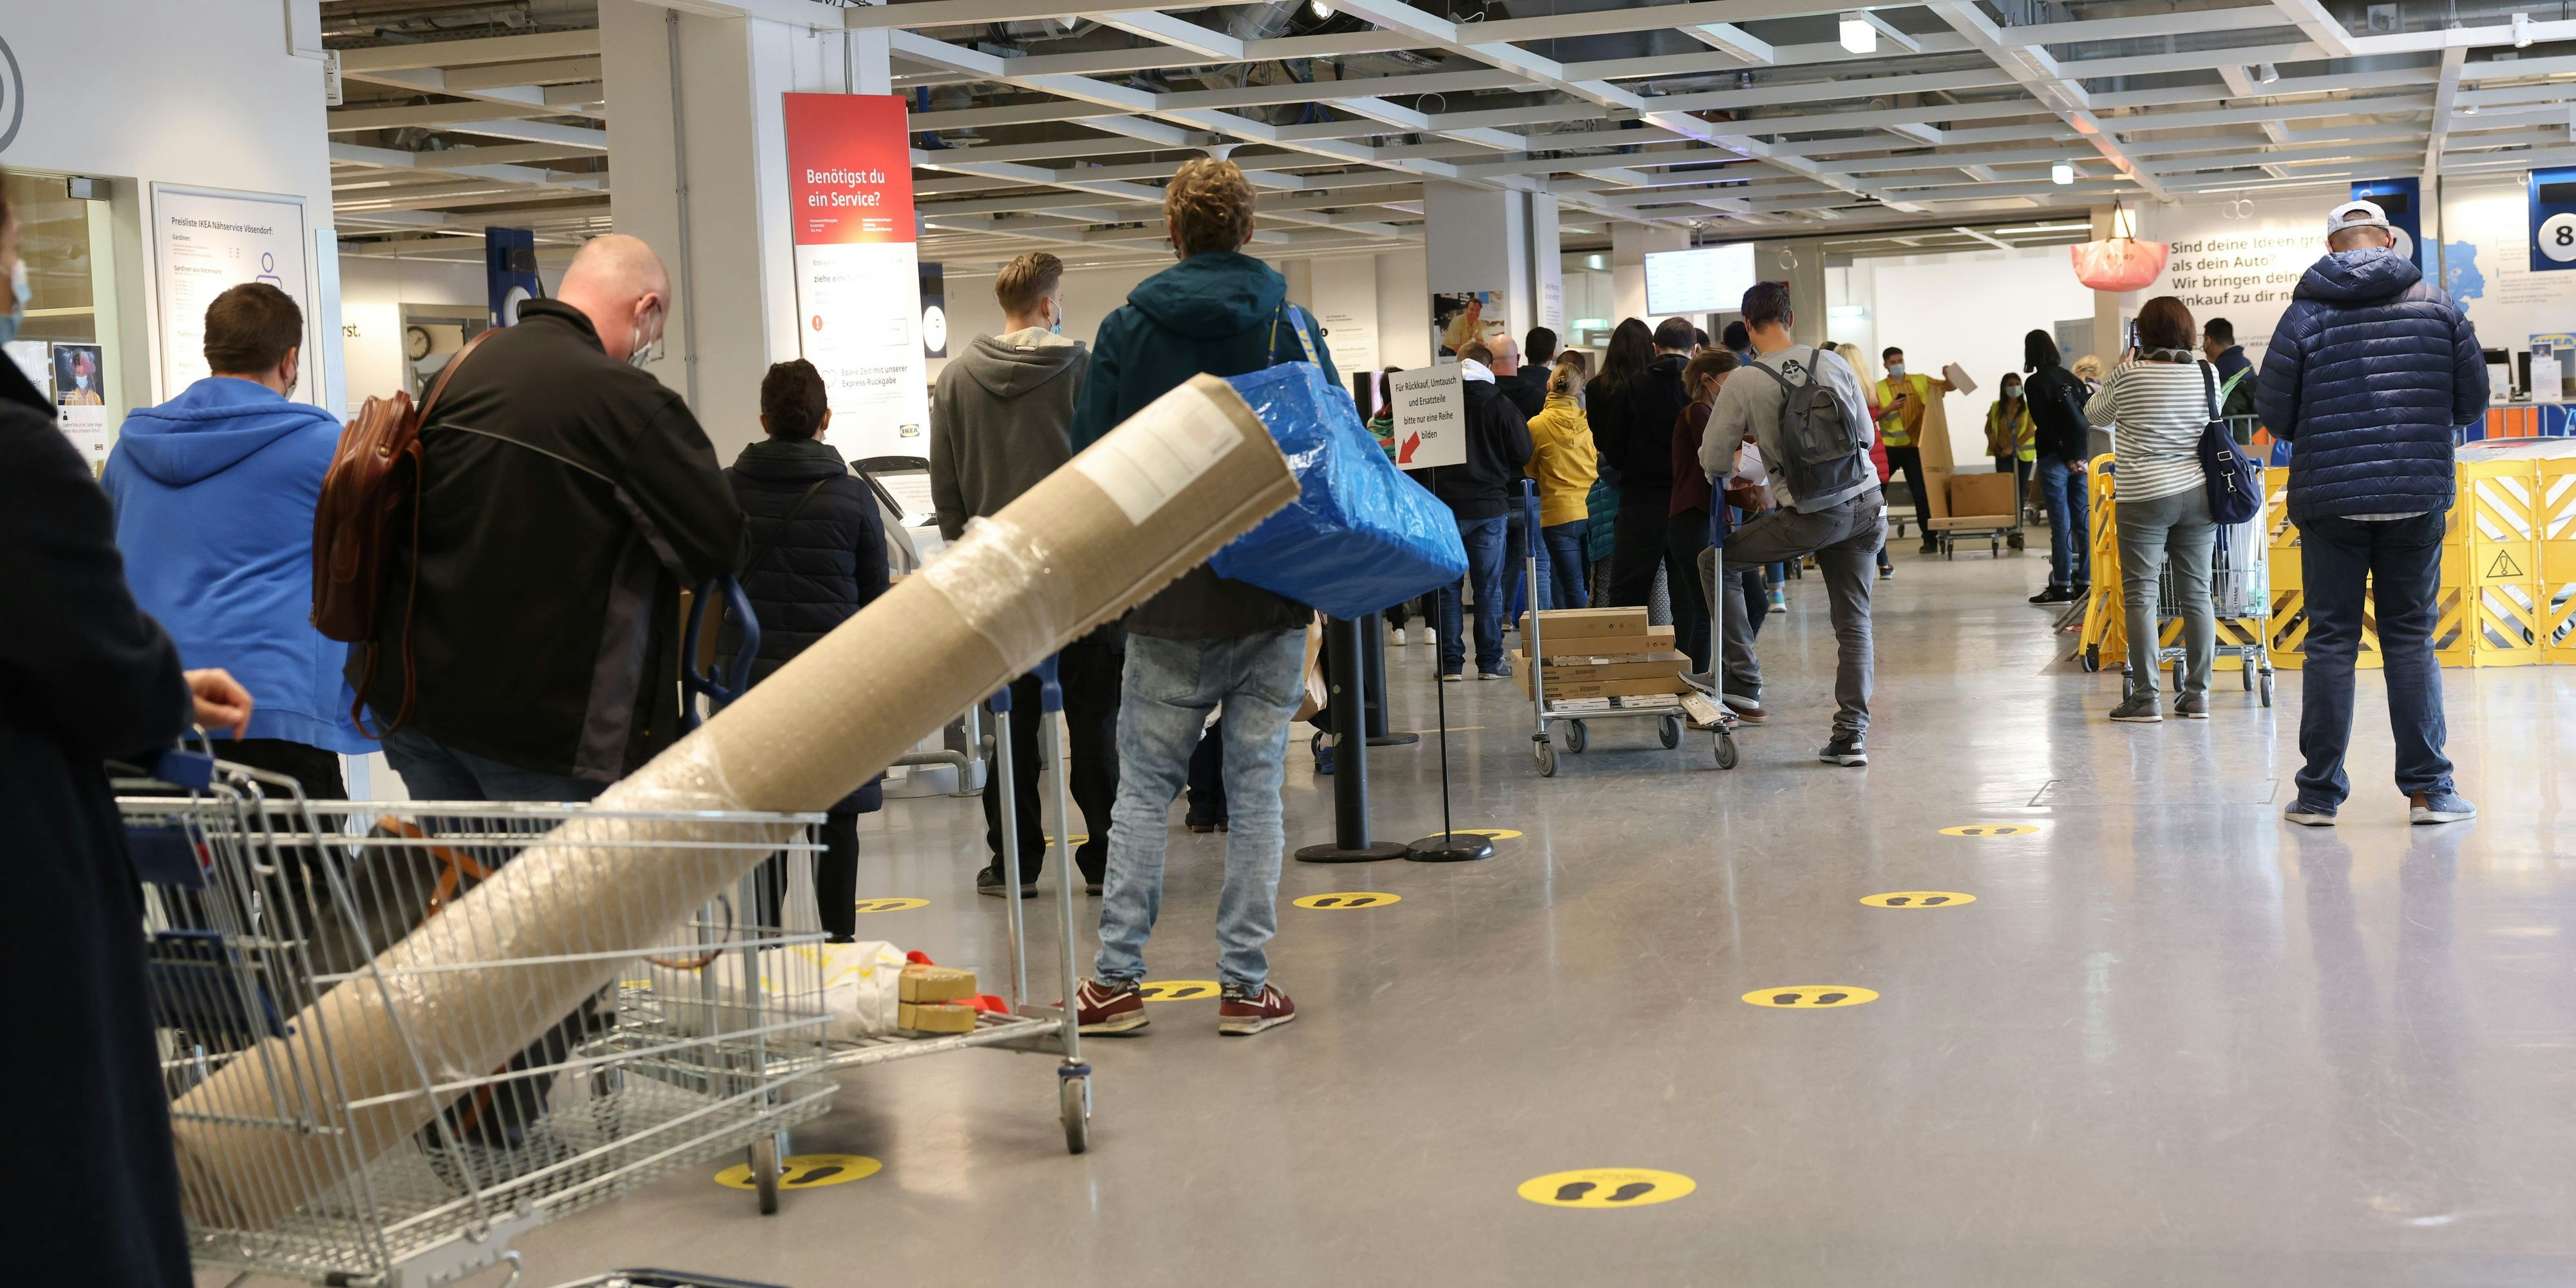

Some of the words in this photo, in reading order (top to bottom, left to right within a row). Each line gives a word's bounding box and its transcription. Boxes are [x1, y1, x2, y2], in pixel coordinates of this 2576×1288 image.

[806, 169, 867, 187] Benötigst
[869, 169, 885, 184] du
[808, 191, 828, 207] ein
[831, 191, 880, 206] Service?
[171, 217, 197, 227] Preisliste
[198, 220, 212, 229] IKEA
[212, 222, 243, 232] Nähservice
[243, 225, 274, 235] Vösendorf:
[2555, 225, 2575, 247] 8
[2172, 241, 2202, 254] Sind
[2208, 239, 2248, 252] deine
[2254, 238, 2294, 249] Ideen
[2173, 259, 2192, 272] als
[2197, 258, 2228, 270] dein
[2234, 254, 2276, 268] Auto?
[814, 274, 831, 283] ziehe
[2172, 276, 2198, 289] Wir
[2203, 274, 2260, 289] bringen
[2233, 293, 2250, 304] zu
[2255, 290, 2275, 302] dir
[841, 368, 858, 378] Spare
[1396, 382, 1405, 392] Für
[1405, 380, 1430, 391] Rückkauf,
[1430, 375, 1457, 387] Umtausch
[1408, 397, 1419, 407] und
[1419, 394, 1446, 406] Ersatzteile
[1404, 415, 1416, 425] bitte
[1427, 413, 1438, 422] eine
[1439, 412, 1454, 421] Reihe
[1421, 430, 1437, 440] bilden
